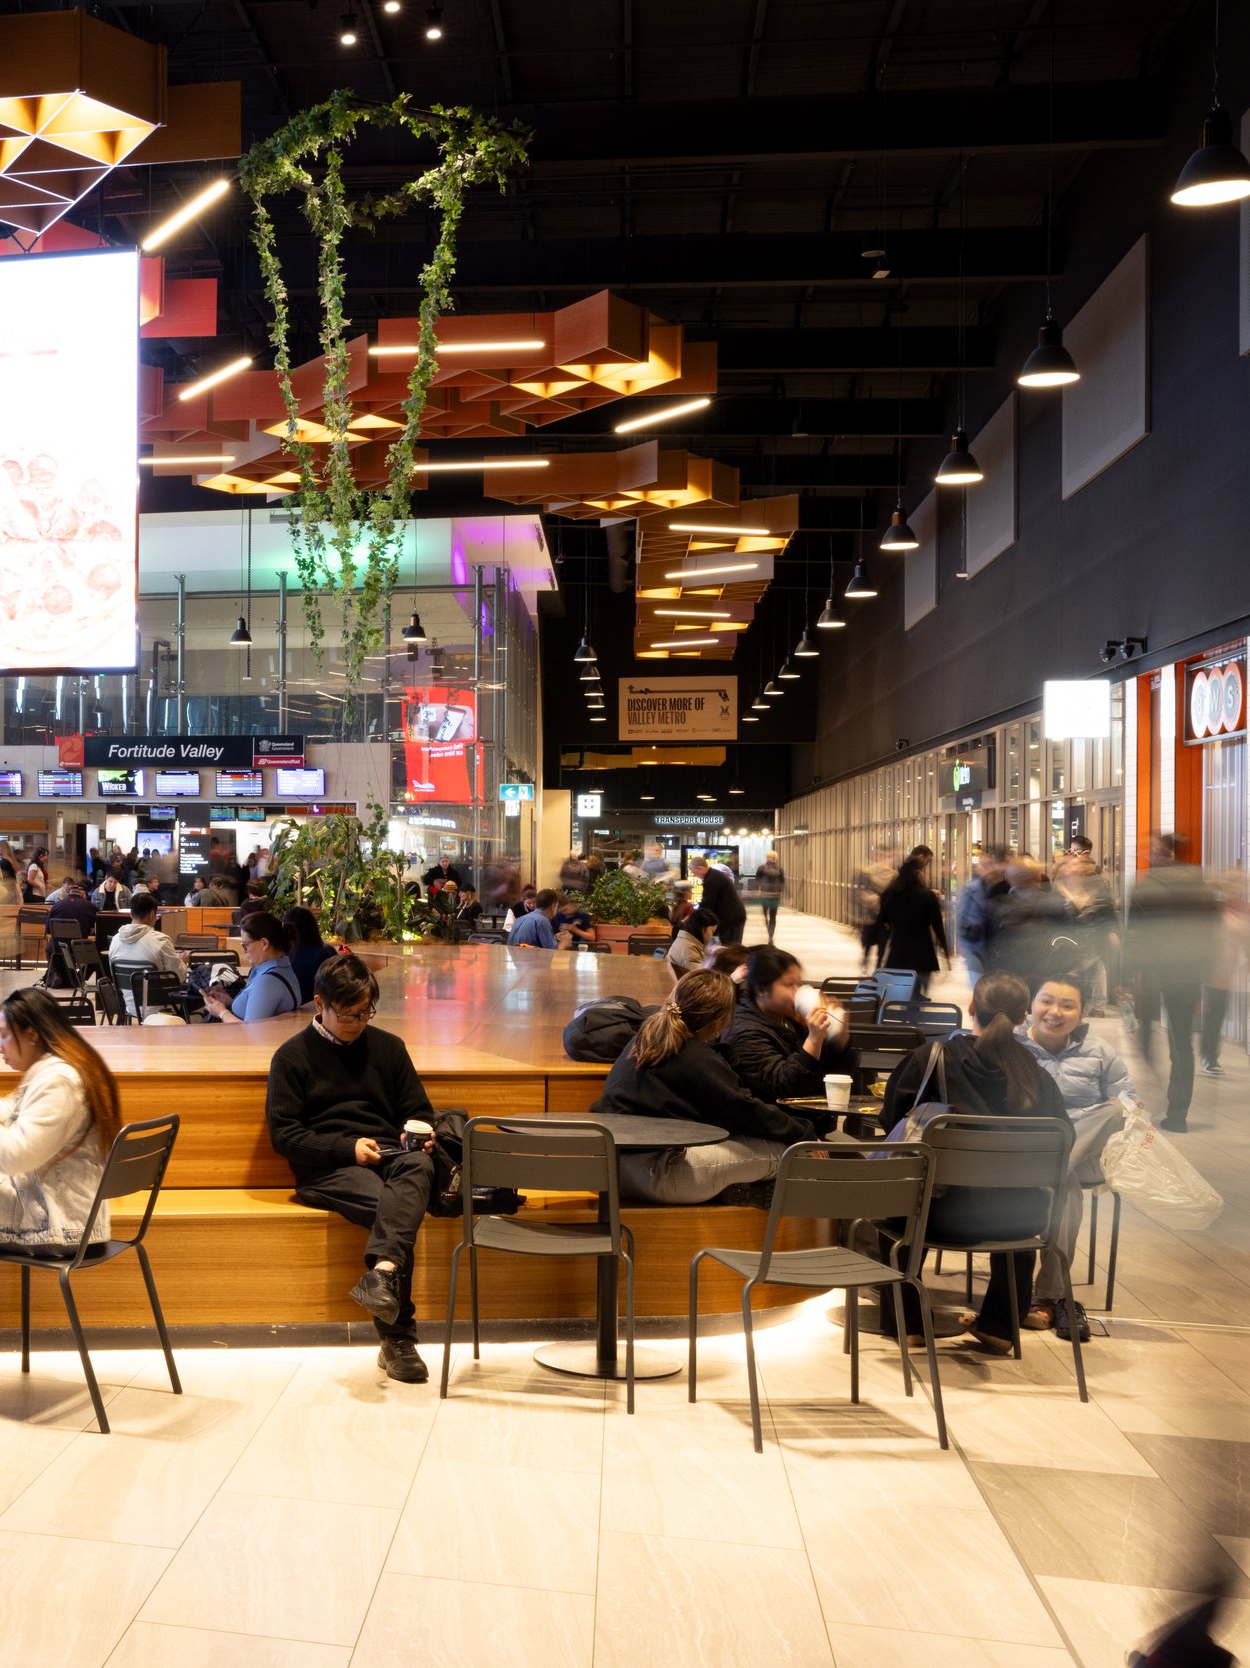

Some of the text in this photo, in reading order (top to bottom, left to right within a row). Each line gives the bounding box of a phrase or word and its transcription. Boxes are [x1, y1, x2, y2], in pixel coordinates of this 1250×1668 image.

[627, 697, 706, 712] DISCOVER MORE OF
[627, 711, 686, 725] VALLEY METRO
[108, 744, 224, 761] Fortitude Valley
[654, 815, 724, 825] TRANSPORT HOUSE
